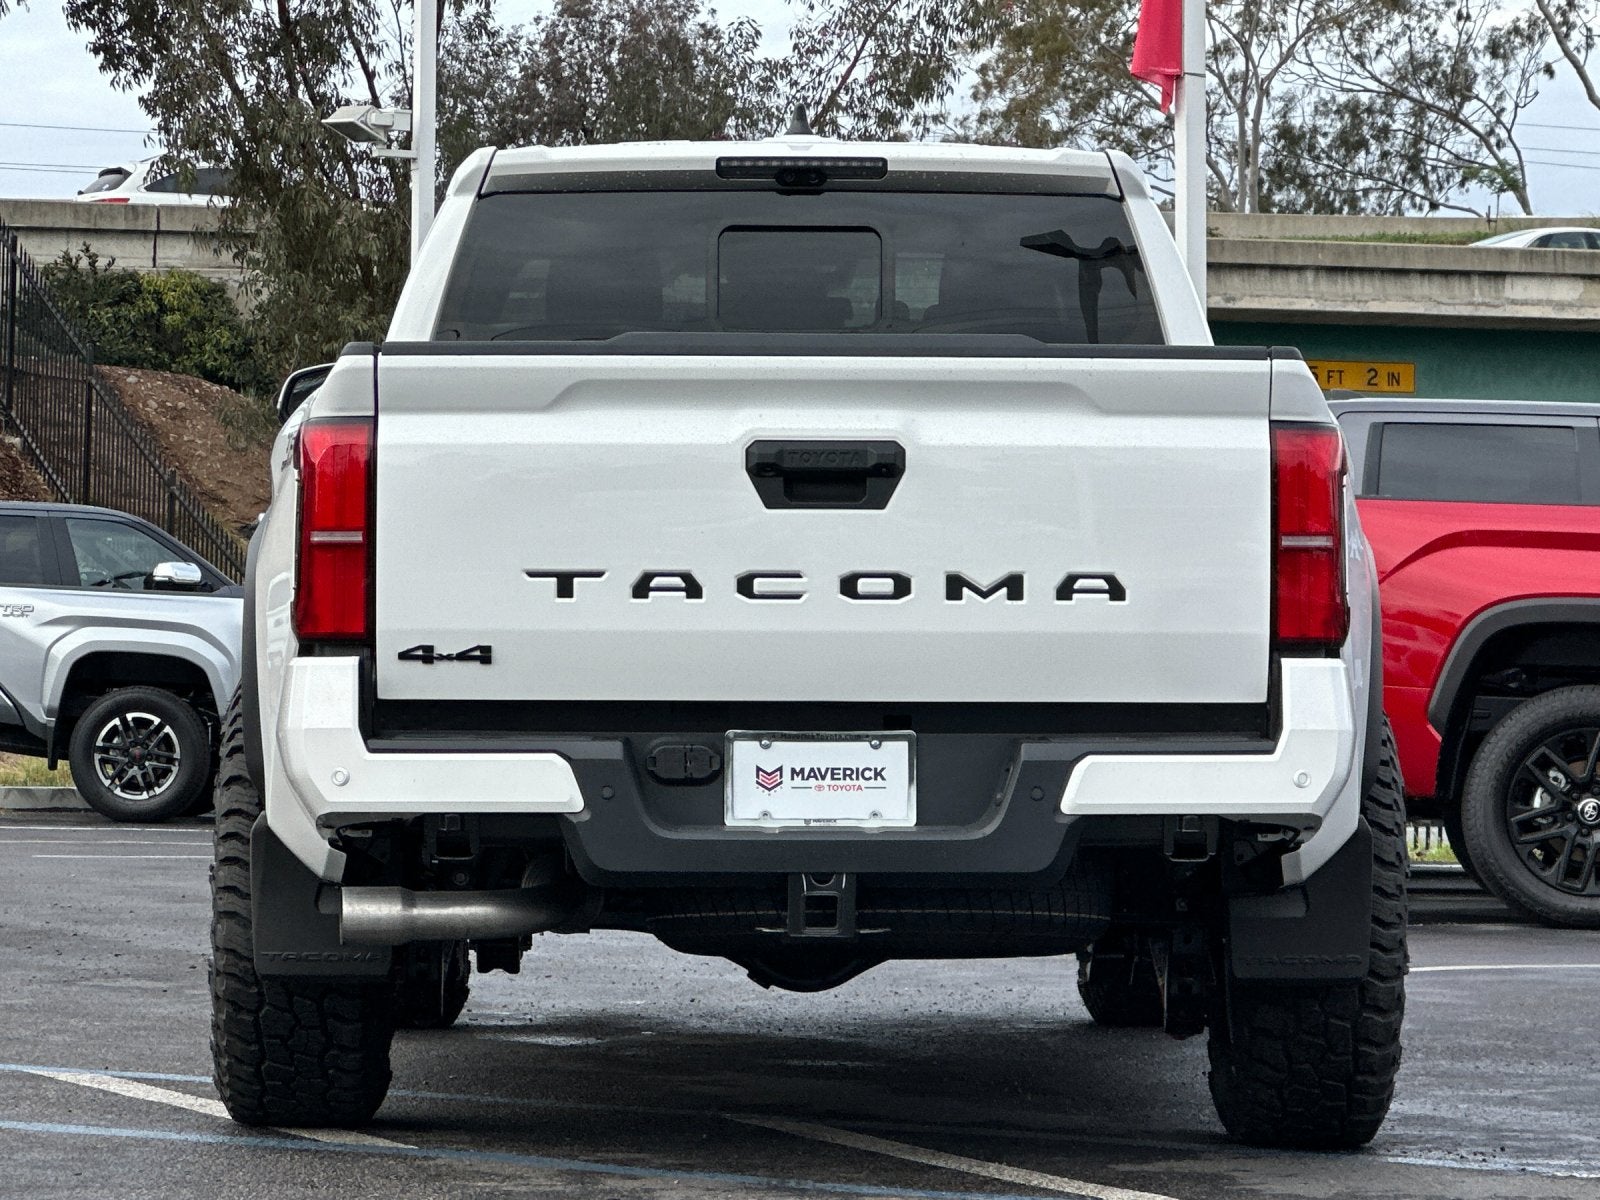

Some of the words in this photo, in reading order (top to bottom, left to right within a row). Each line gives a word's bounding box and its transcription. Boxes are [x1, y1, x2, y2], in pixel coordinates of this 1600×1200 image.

[1327, 370, 1345, 385] FT
[1367, 368, 1378, 386] 2
[1387, 371, 1400, 386] IN
[787, 450, 861, 465] TOYOTA
[522, 569, 1128, 602] TACOMA
[790, 767, 886, 781] MAVERICK
[827, 784, 863, 792] TOYOTA
